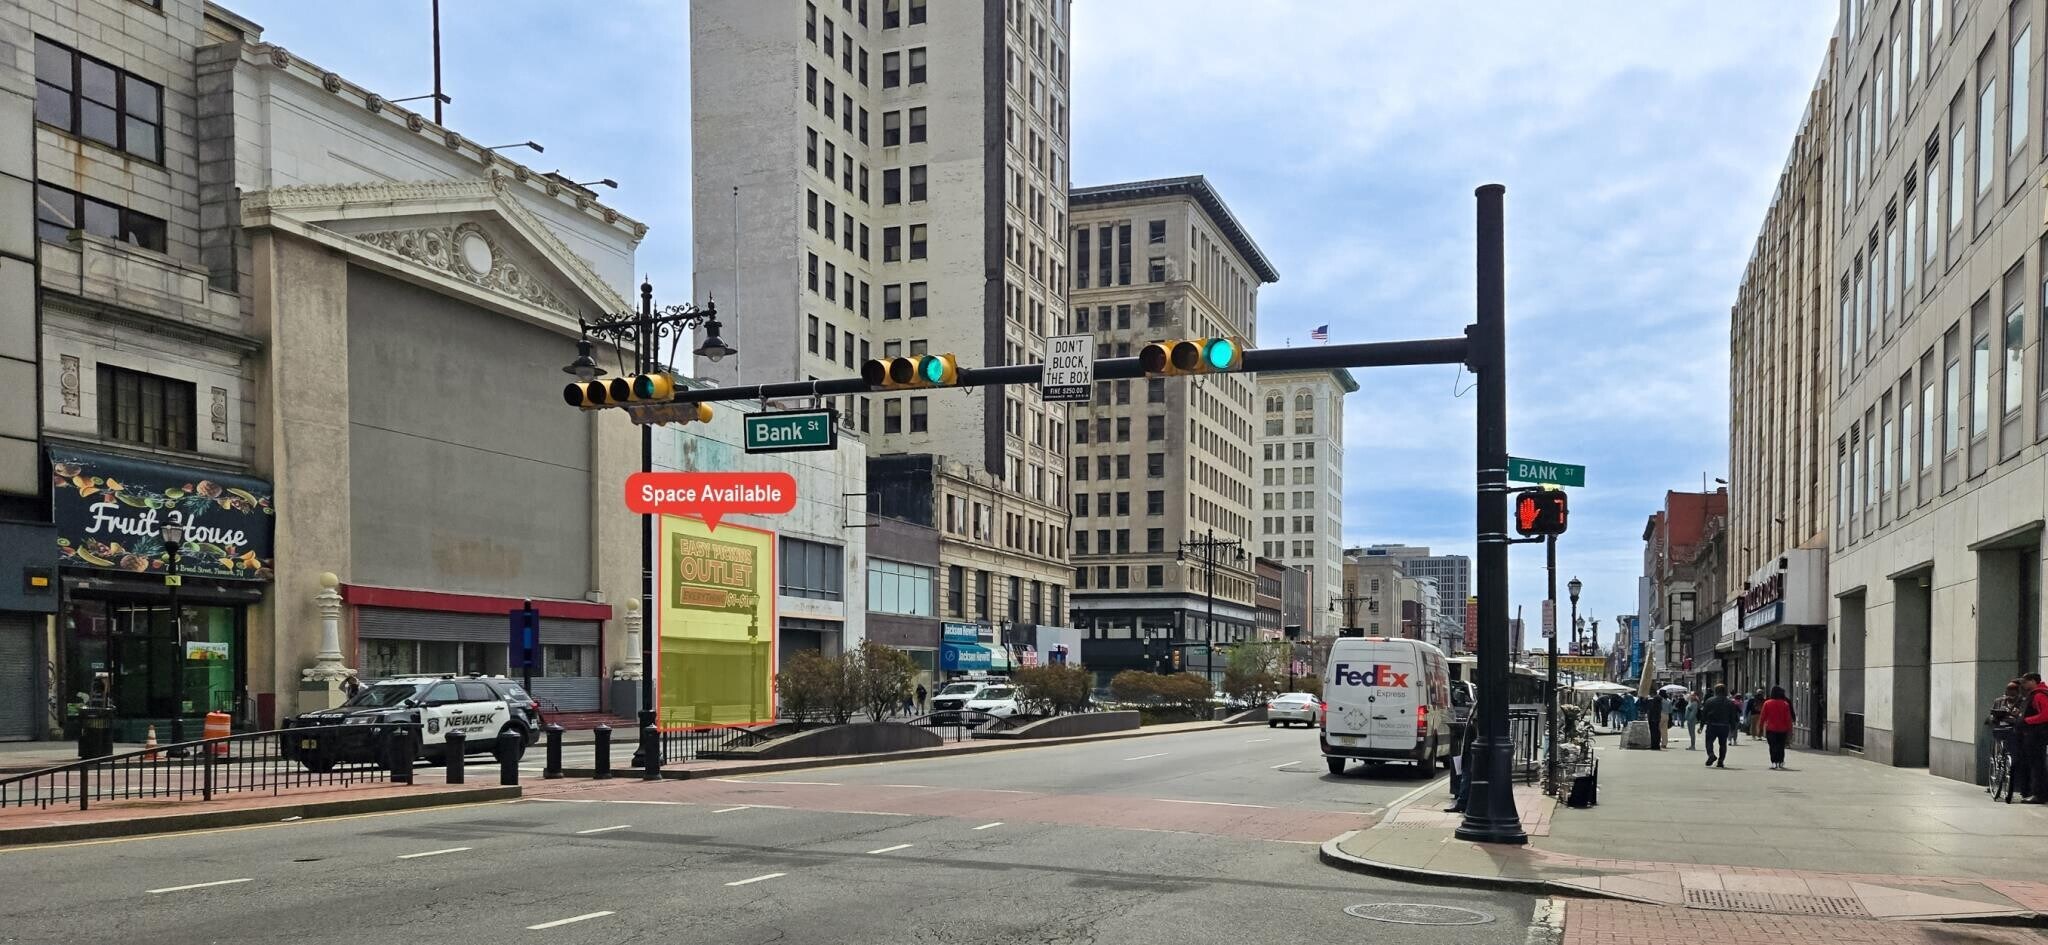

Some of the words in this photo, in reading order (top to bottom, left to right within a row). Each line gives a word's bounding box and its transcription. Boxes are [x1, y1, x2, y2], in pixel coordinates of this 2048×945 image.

[1056, 340, 1084, 353] DON'T
[1053, 356, 1084, 369] BLOCK
[1047, 372, 1064, 385] THE
[1070, 371, 1089, 384] BOX
[756, 422, 803, 442] Bank
[807, 421, 819, 431] St
[1519, 464, 1558, 480] BANK
[1565, 468, 1574, 477] ST
[85, 502, 160, 538] Fruit
[680, 539, 710, 558] EASY
[680, 556, 752, 588] OUTLET
[945, 624, 963, 636] Jackson
[959, 651, 976, 662] Jackson
[1335, 663, 1409, 688] FedEx
[1376, 690, 1406, 698] Express
[445, 713, 495, 727] NEWARK
